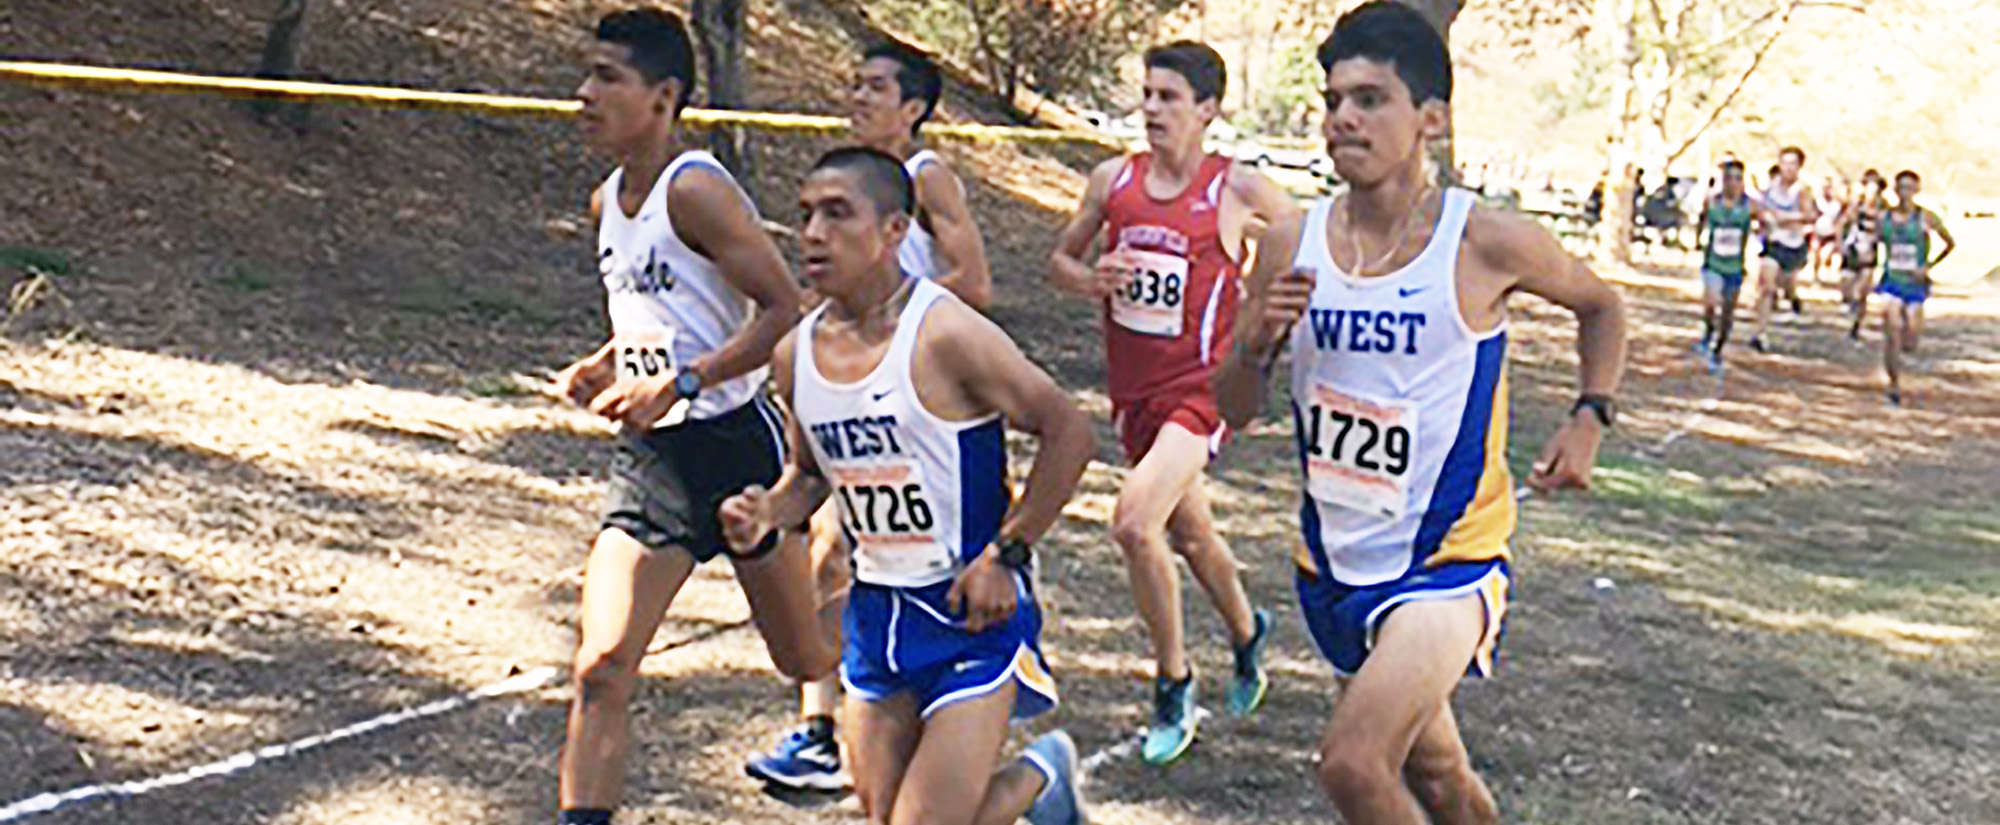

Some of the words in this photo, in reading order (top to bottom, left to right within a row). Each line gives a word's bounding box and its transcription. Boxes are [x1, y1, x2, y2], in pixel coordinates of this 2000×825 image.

[1114, 266, 1181, 308] 638
[1310, 309, 1425, 353] WEST
[811, 415, 901, 459] WEST
[1309, 405, 1410, 475] 1729
[839, 484, 933, 532] 1726
